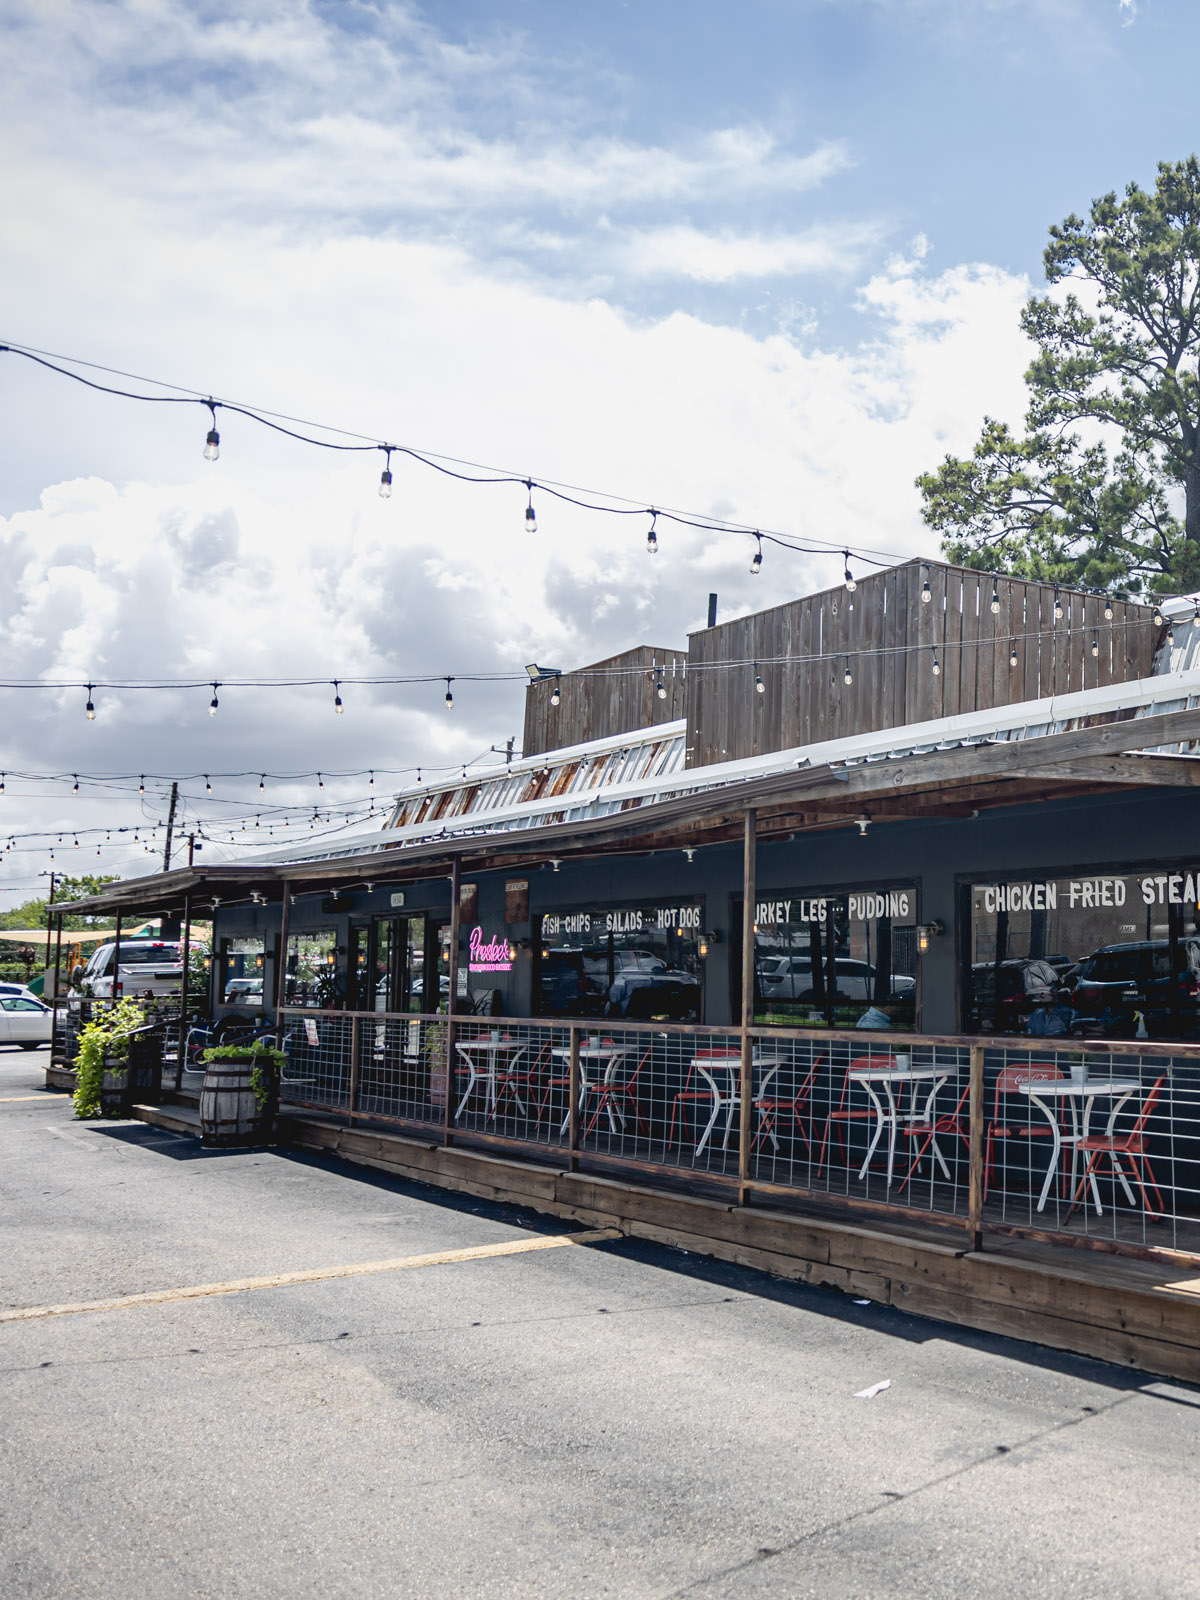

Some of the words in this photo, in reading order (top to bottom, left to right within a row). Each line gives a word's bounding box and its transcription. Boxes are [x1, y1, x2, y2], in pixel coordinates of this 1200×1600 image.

[755, 900, 792, 925] URKEY
[800, 898, 827, 922] LEG
[848, 893, 909, 921] PUDDING
[985, 883, 1057, 913] CHICKEN
[1069, 880, 1126, 909] FRIED
[542, 916, 560, 935] FISH
[564, 914, 591, 933] CHIPS
[606, 911, 643, 932] SALADS
[657, 908, 679, 929] HOT
[679, 907, 700, 928] DOG
